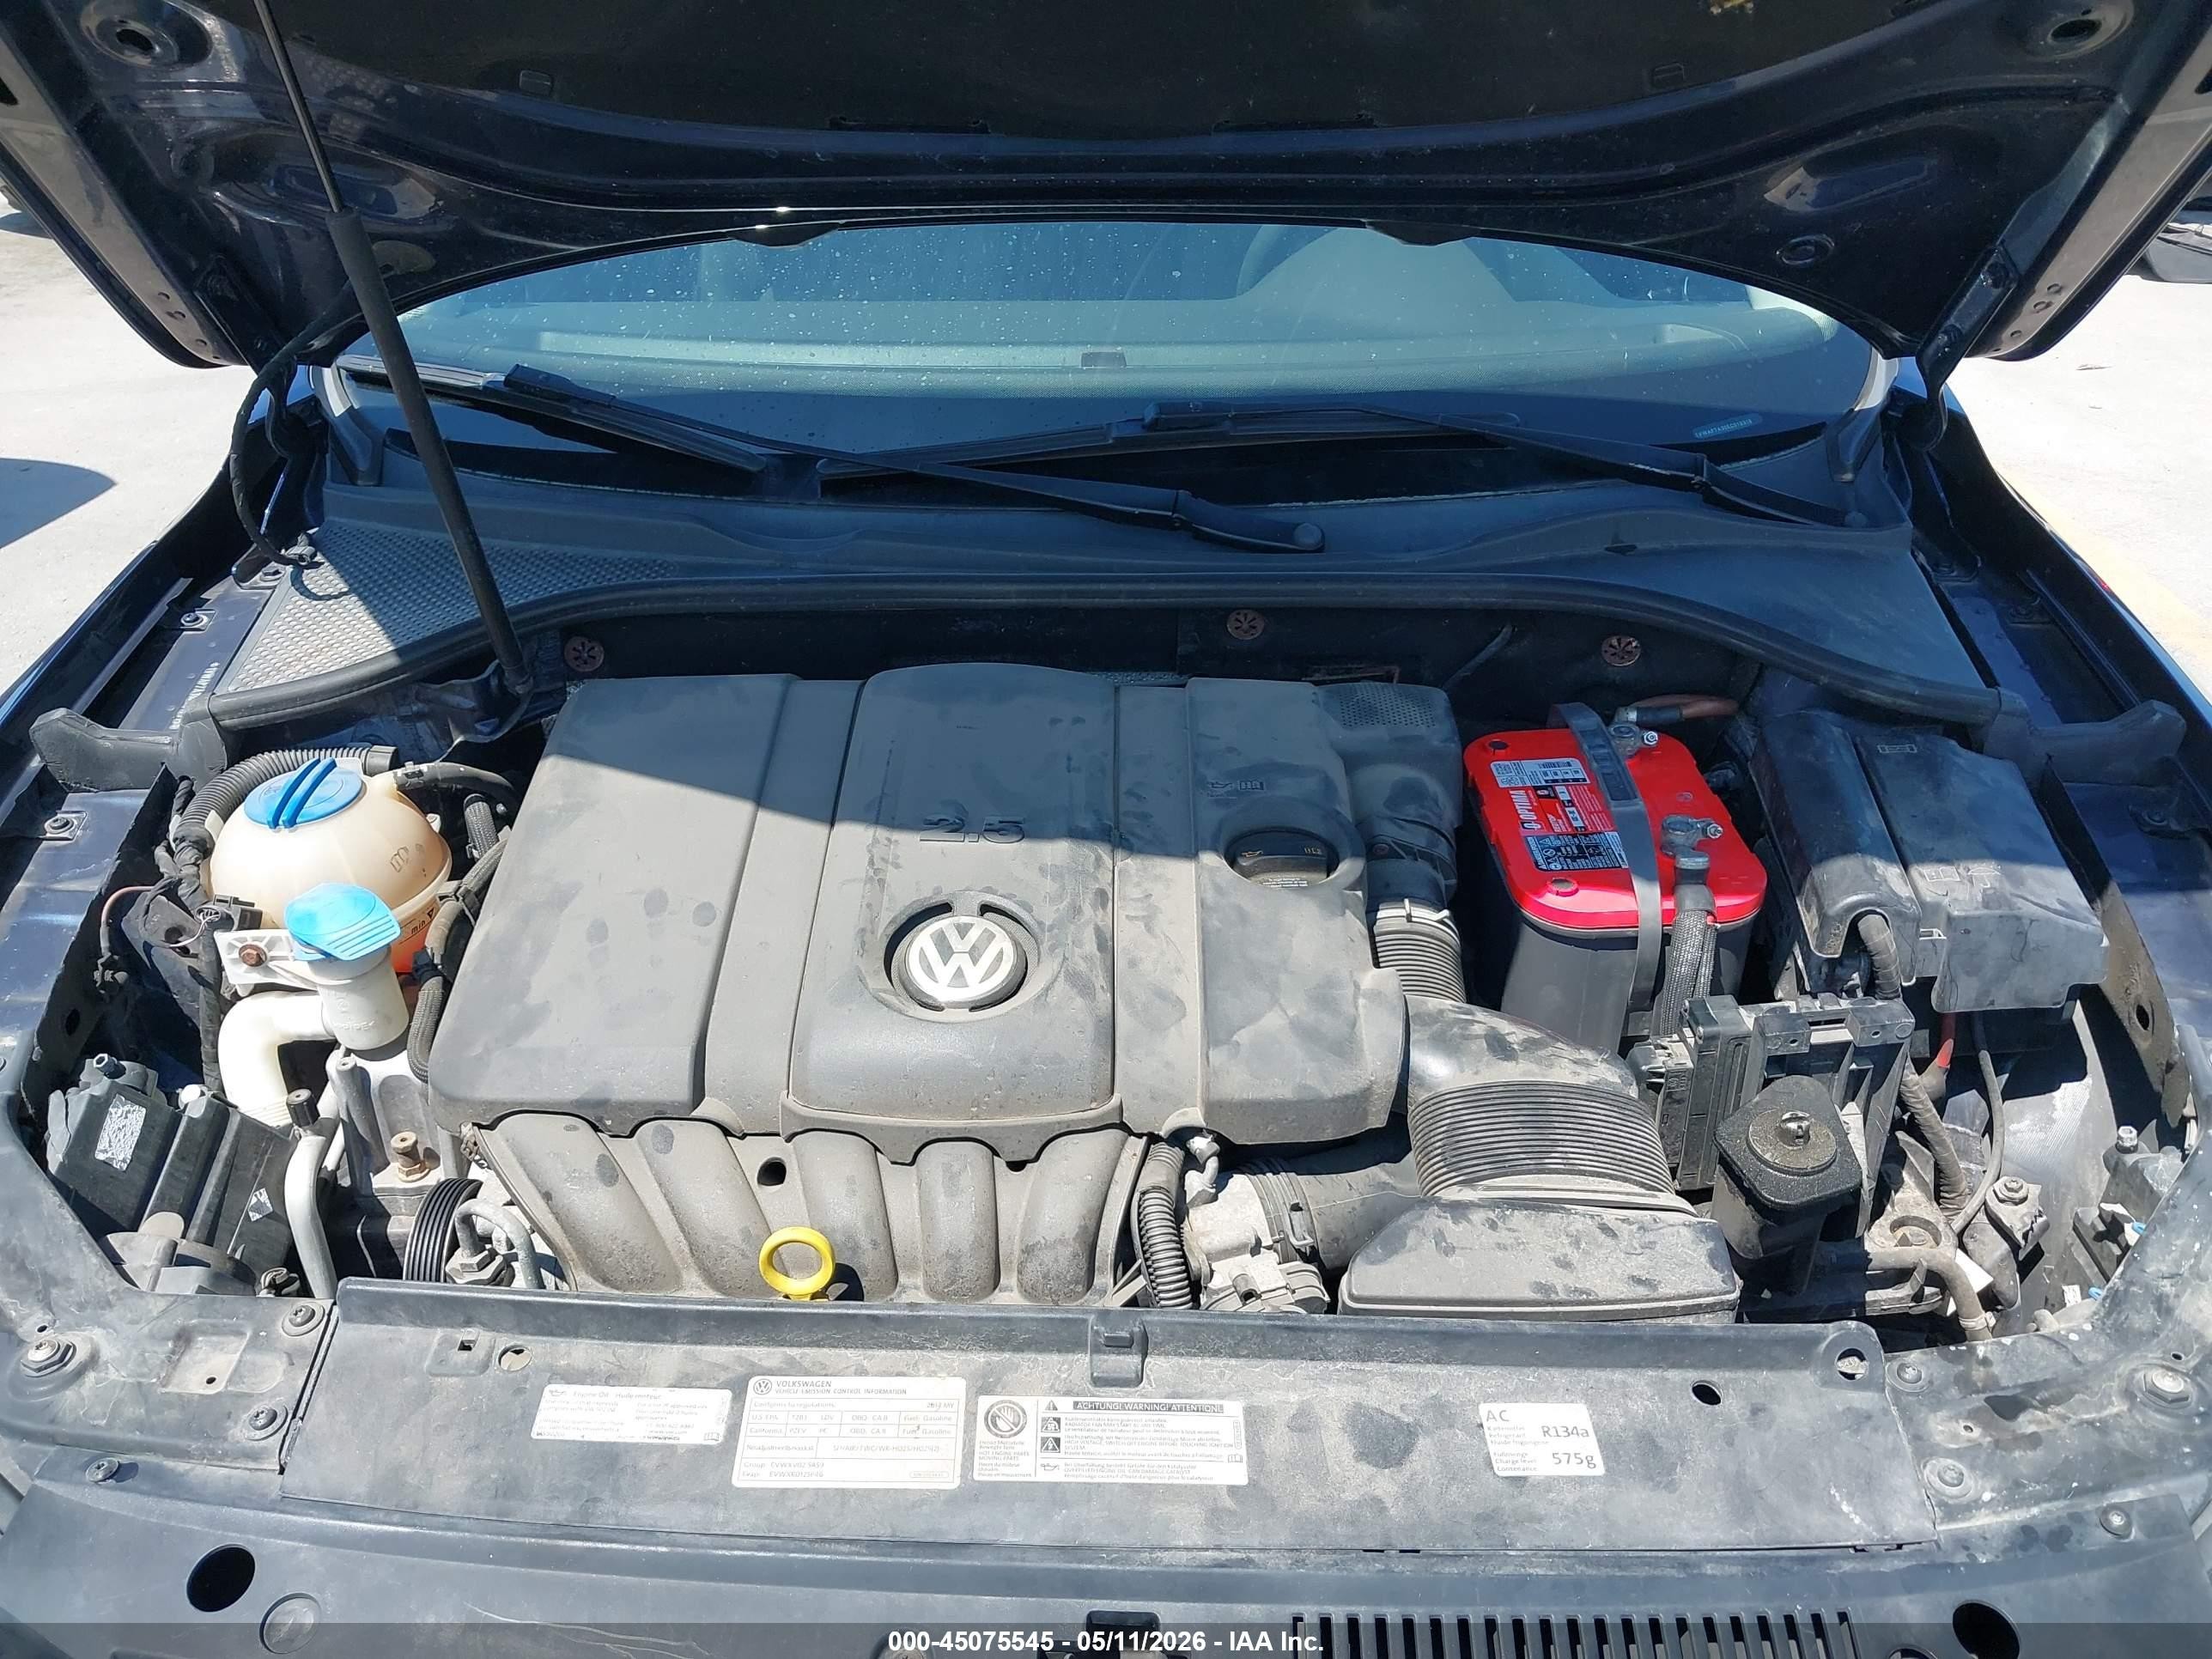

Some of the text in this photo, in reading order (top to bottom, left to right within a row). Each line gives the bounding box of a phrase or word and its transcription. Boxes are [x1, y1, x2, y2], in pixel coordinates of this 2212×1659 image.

[920, 814, 1024, 844] 2.5
[410, 919, 426, 935] min
[1077, 1401, 1121, 1410] ACHTUNG!
[1170, 1403, 1224, 1413] ATTENTION!
[1540, 1425, 1589, 1437] R134a
